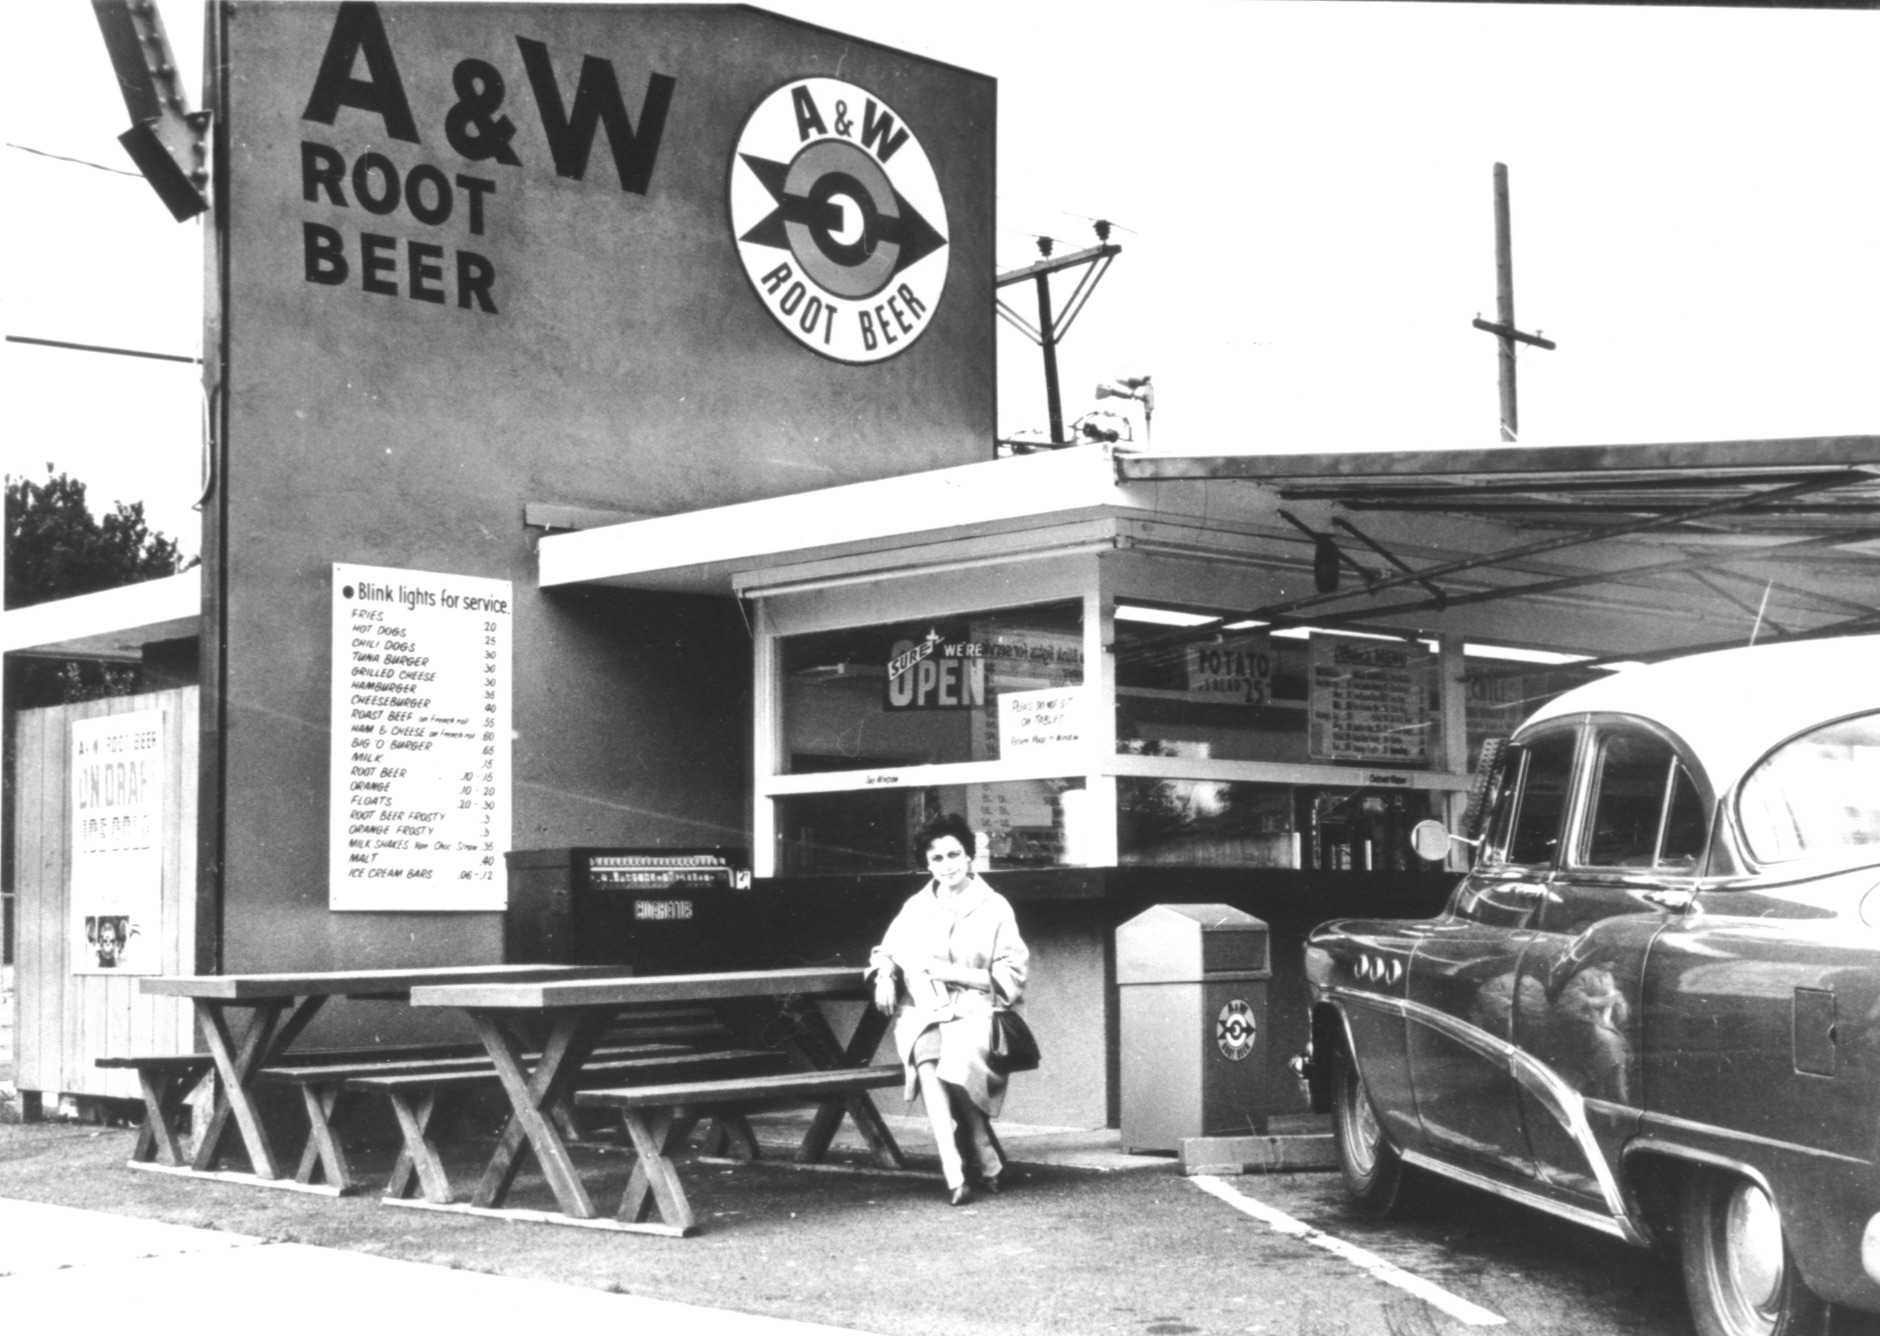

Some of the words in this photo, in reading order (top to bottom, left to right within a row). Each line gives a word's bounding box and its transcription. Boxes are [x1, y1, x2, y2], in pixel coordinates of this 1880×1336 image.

[302, 0, 676, 196] A&W
[790, 85, 910, 163] A&W
[301, 140, 496, 235] ROOT
[303, 221, 499, 314] BEER
[760, 262, 837, 345] ROOT
[858, 282, 927, 352] BEER
[359, 582, 394, 602] Blink
[399, 585, 436, 611] lights
[441, 589, 459, 608] for
[352, 609, 384, 621] FRIES
[353, 625, 373, 633] HOT
[377, 626, 407, 637] DOGS
[352, 638, 379, 648] CHILI
[384, 640, 415, 652] DOGS
[944, 643, 983, 657] WE'RE
[352, 652, 379, 662] TUNA
[384, 654, 429, 666] BURGER
[891, 643, 933, 678] SURE
[1199, 648, 1269, 678] POTATO
[352, 667, 394, 678] GRILLED
[399, 671, 436, 681] CHEESE
[890, 639, 985, 706] OPEN
[351, 681, 417, 693] HAMBURGER
[351, 695, 431, 708] CHEESEBURGER
[352, 709, 383, 720] ROAST
[388, 711, 413, 721] BEEF
[352, 725, 374, 733] HAM
[379, 726, 387, 735] &
[391, 726, 425, 737] CHEESE
[351, 738, 371, 749] BIG
[390, 740, 433, 751] BURGER
[352, 752, 383, 763] MILK
[351, 766, 376, 776] ROOT
[380, 768, 407, 778] BEER
[350, 781, 391, 792] ORANGE
[351, 795, 392, 806] FLOATS
[350, 810, 375, 820] ROOT
[379, 810, 405, 821] BEER
[408, 812, 446, 822] FROSTY
[349, 825, 390, 835] ORANGE
[396, 825, 434, 836] FROSTY
[349, 839, 371, 848] MILK
[374, 839, 409, 850] SHAKES
[349, 853, 378, 863] MALT
[349, 868, 365, 878] ICE
[368, 869, 403, 879] CREAM
[407, 869, 433, 879] BARS
